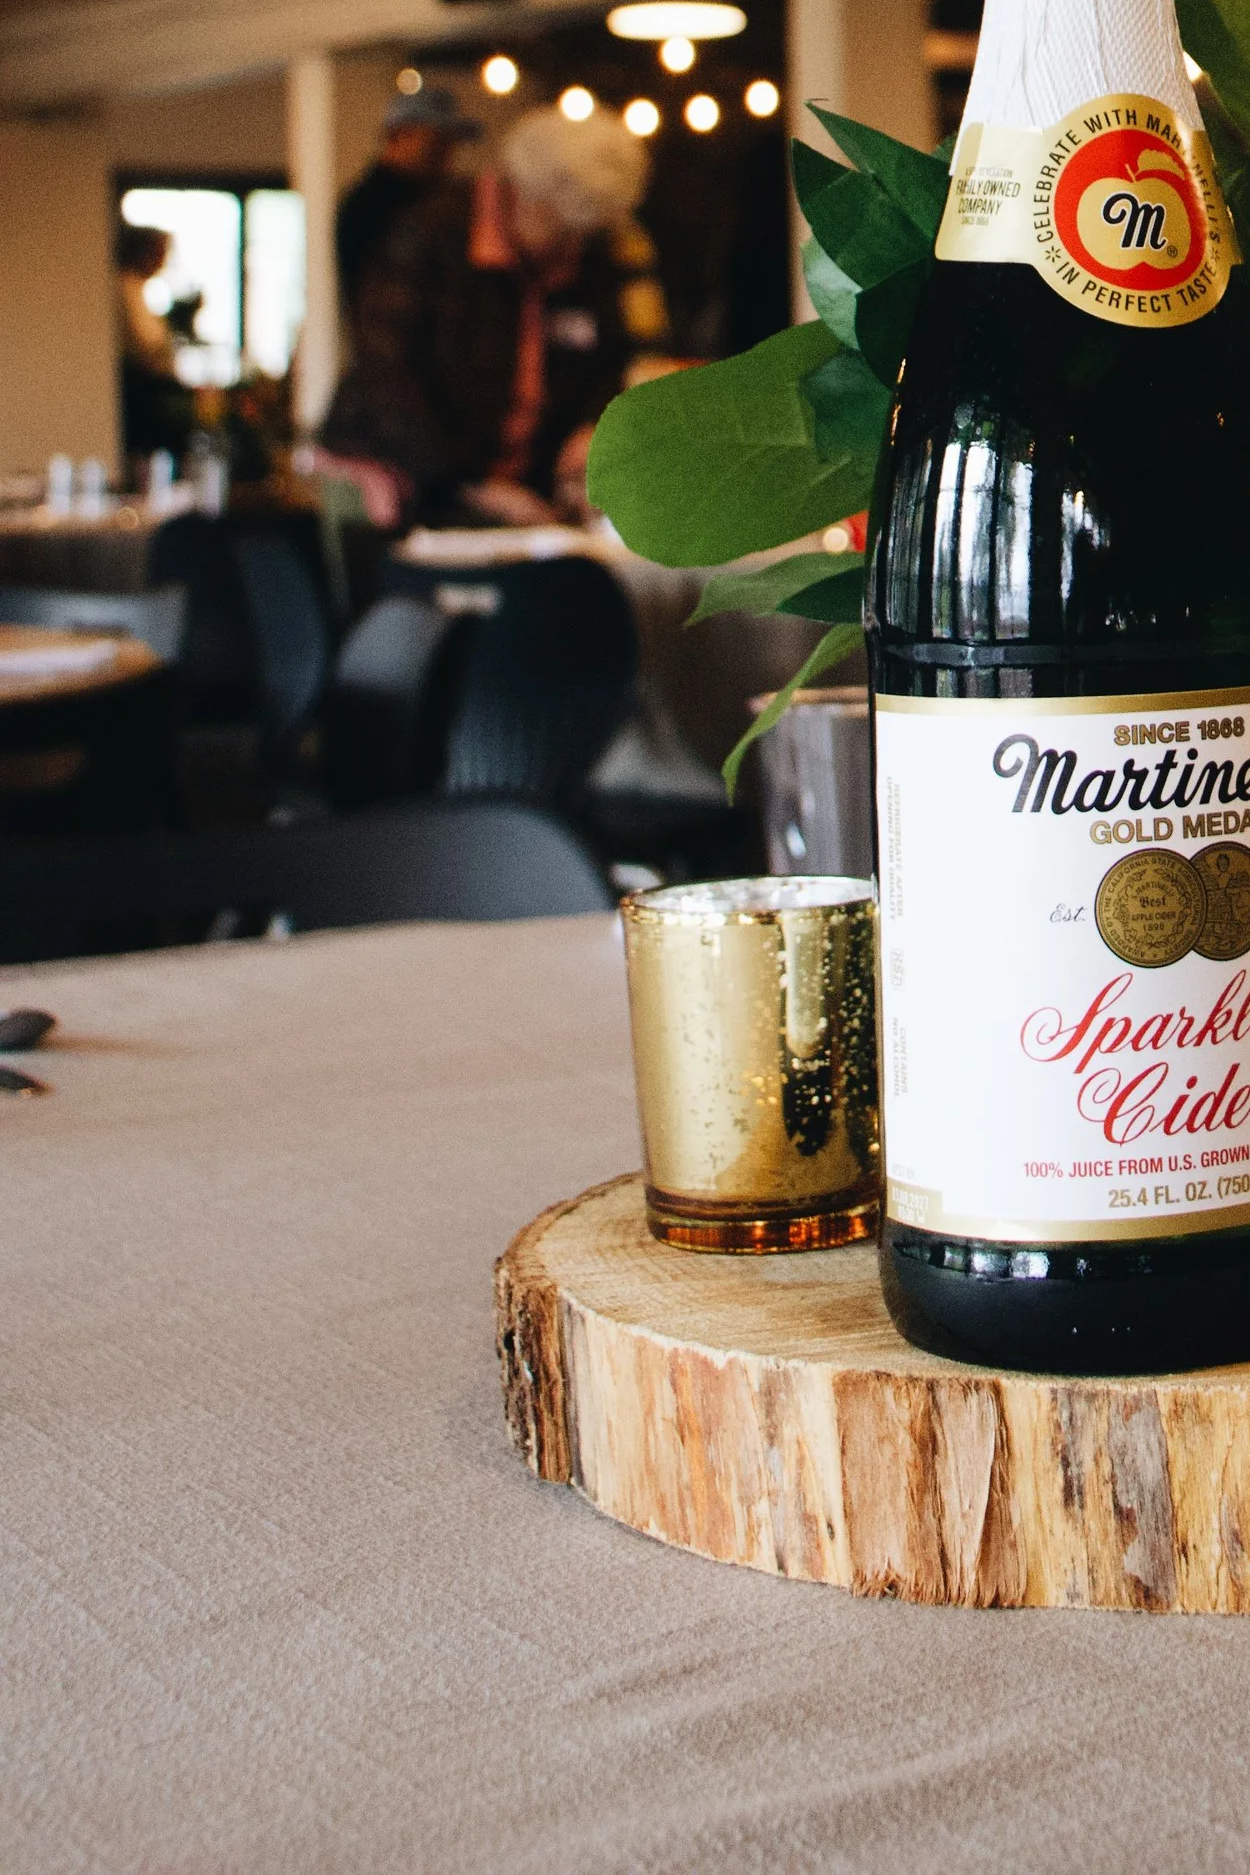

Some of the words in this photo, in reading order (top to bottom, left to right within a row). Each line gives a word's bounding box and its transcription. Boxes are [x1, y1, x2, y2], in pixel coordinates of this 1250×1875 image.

[983, 180, 1021, 198] OWNED
[1033, 128, 1082, 245] CELEBRATE
[1083, 107, 1138, 133] WITH
[958, 197, 1003, 216] COMPANY
[1056, 260, 1081, 286] IN
[1081, 279, 1172, 314] PERFECT
[1177, 263, 1218, 306] TASTE
[1113, 720, 1191, 747] SINCE
[1196, 716, 1246, 741] 1868
[1089, 816, 1175, 846] GOLD
[1103, 894, 1113, 913] THE
[1108, 859, 1150, 894] CALIFORNIA
[1151, 857, 1177, 870] STATE
[1048, 902, 1087, 925] Est.
[1131, 913, 1155, 922] APPLE
[1138, 896, 1167, 909] Best
[1022, 1161, 1064, 1179] 100%
[1068, 1159, 1114, 1178] JUICE
[1118, 1155, 1164, 1177] FROM
[1167, 1152, 1197, 1172] U.S.
[1200, 1146, 1250, 1170] GROWN
[1108, 1186, 1150, 1210] 25.4
[1153, 1184, 1185, 1206] FL.
[1185, 1180, 1214, 1203] OZ.
